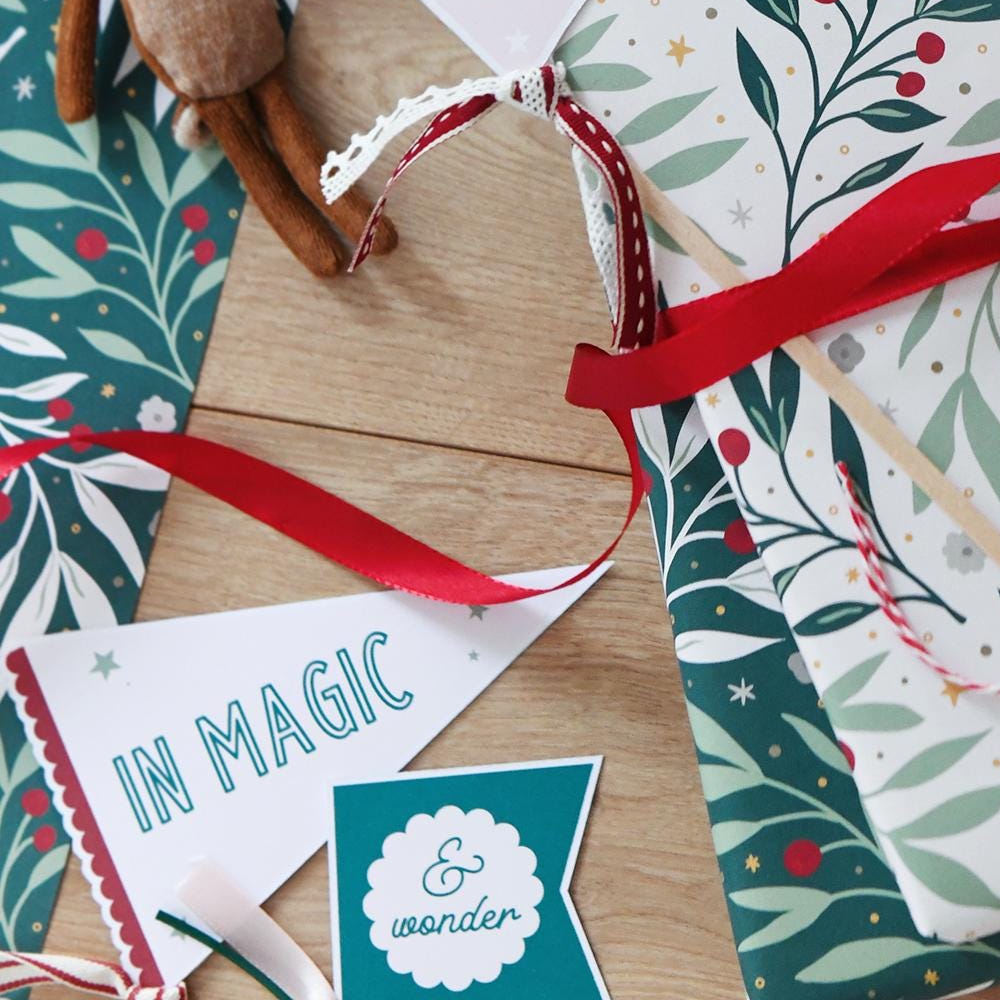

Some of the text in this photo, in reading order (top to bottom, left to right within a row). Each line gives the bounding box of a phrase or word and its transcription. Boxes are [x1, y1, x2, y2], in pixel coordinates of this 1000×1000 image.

[112, 631, 414, 833] IN MAGIC
[422, 837, 485, 897] &
[391, 896, 522, 939] wonder
